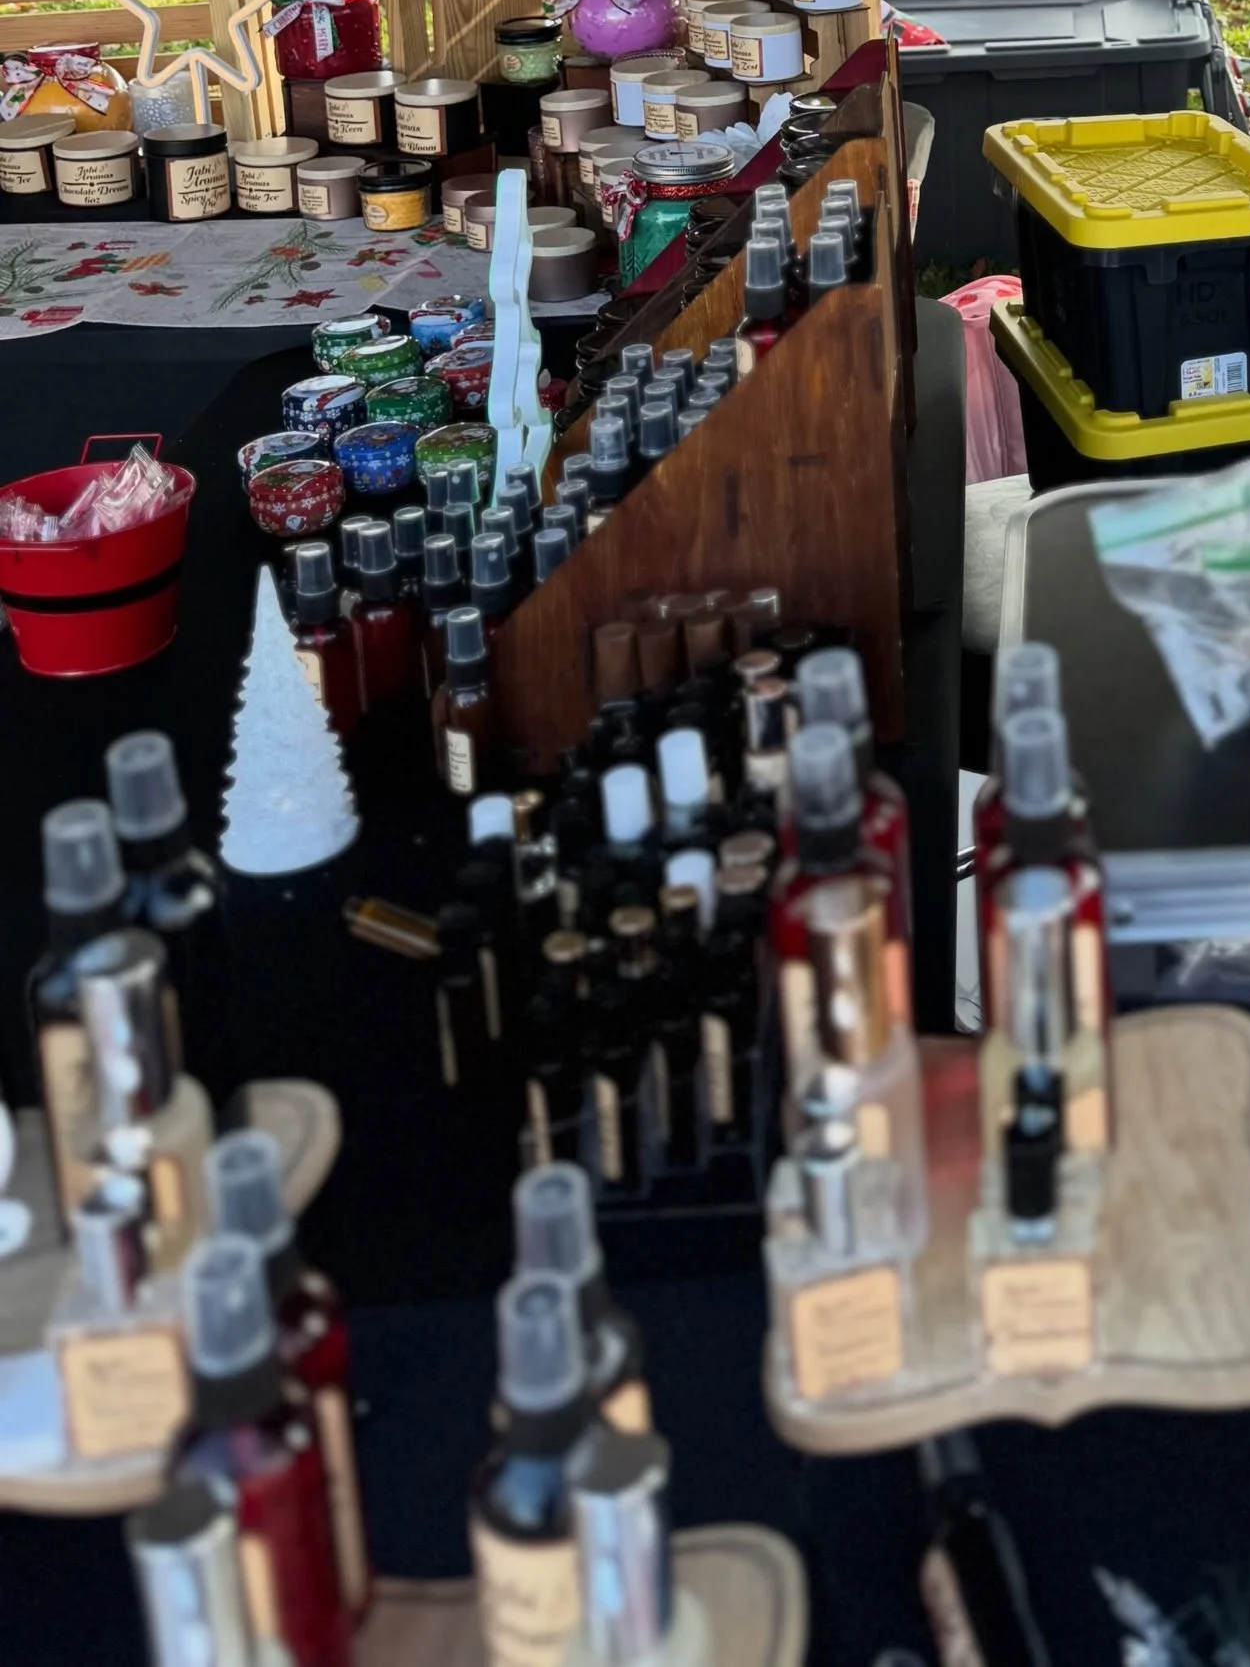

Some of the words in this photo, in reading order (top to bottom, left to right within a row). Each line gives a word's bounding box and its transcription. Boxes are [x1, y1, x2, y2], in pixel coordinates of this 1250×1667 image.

[184, 164, 212, 182] Jabi
[184, 174, 226, 189] Aromas
[181, 194, 206, 206] Spicy
